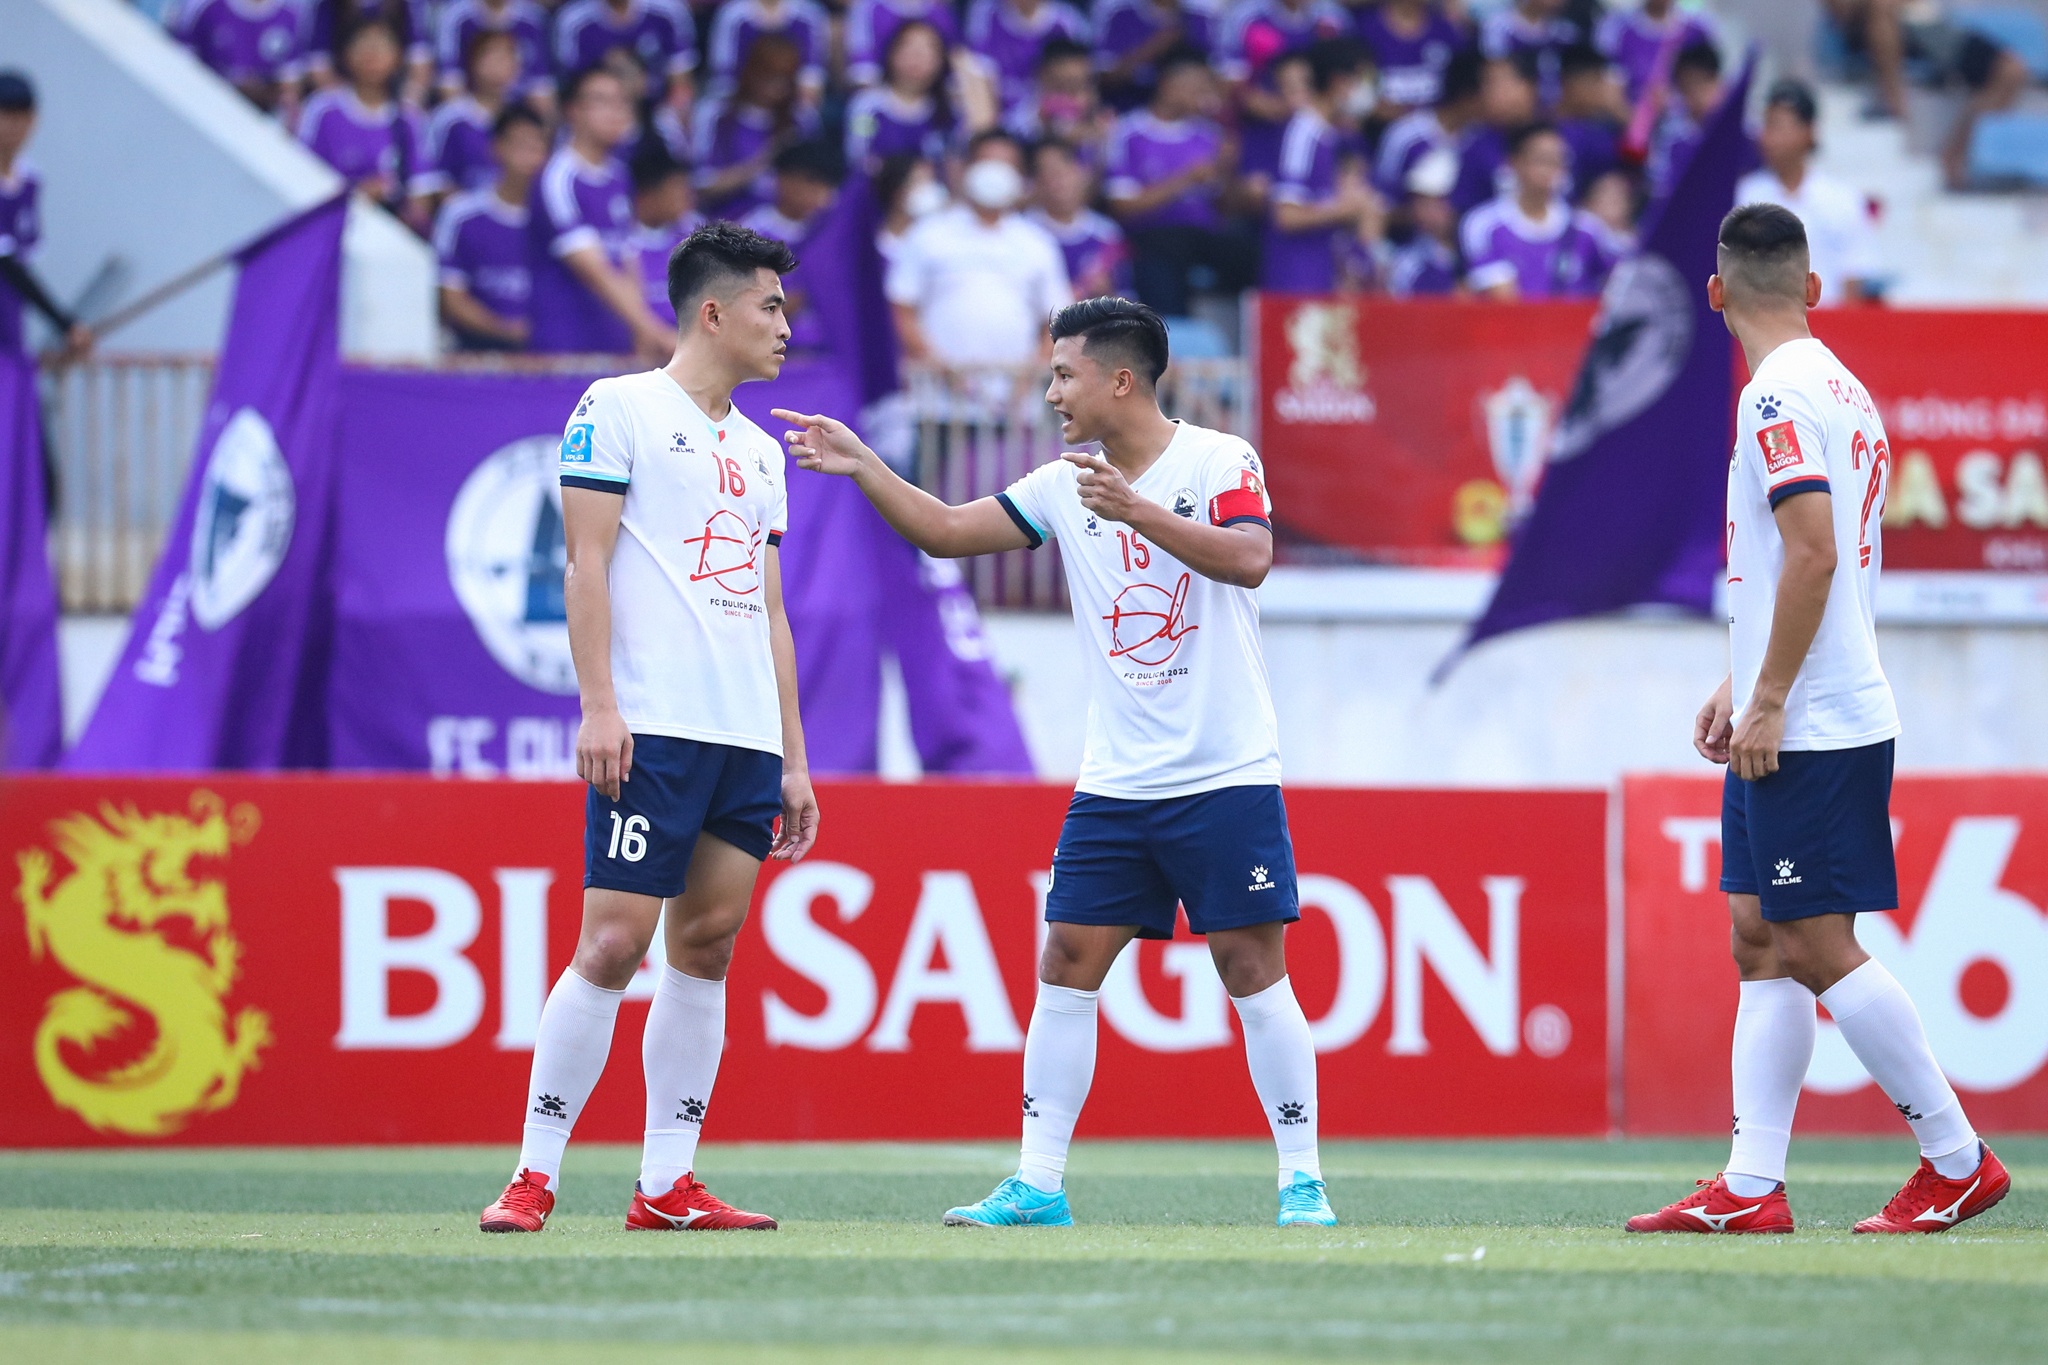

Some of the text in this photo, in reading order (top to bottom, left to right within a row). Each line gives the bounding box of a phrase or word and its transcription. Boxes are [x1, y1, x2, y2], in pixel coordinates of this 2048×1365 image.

[669, 446, 696, 454] KELME
[1768, 455, 1799, 472] SAIGON
[712, 451, 746, 497] 16
[1116, 530, 1150, 572] 15
[710, 598, 720, 606] FC
[722, 600, 748, 610] DULICH
[1137, 670, 1165, 680] DULICH
[1167, 667, 1189, 677] 2022
[1157, 678, 1173, 686] 2008
[607, 810, 650, 862] 16
[1248, 881, 1276, 892] KELME
[1772, 876, 1803, 886] KELME
[334, 860, 1526, 1058] BI SAGON
[534, 1106, 568, 1119] KELME
[675, 1112, 704, 1126] KELM
[1023, 1109, 1039, 1119] LME
[1277, 1116, 1309, 1126] KELME
